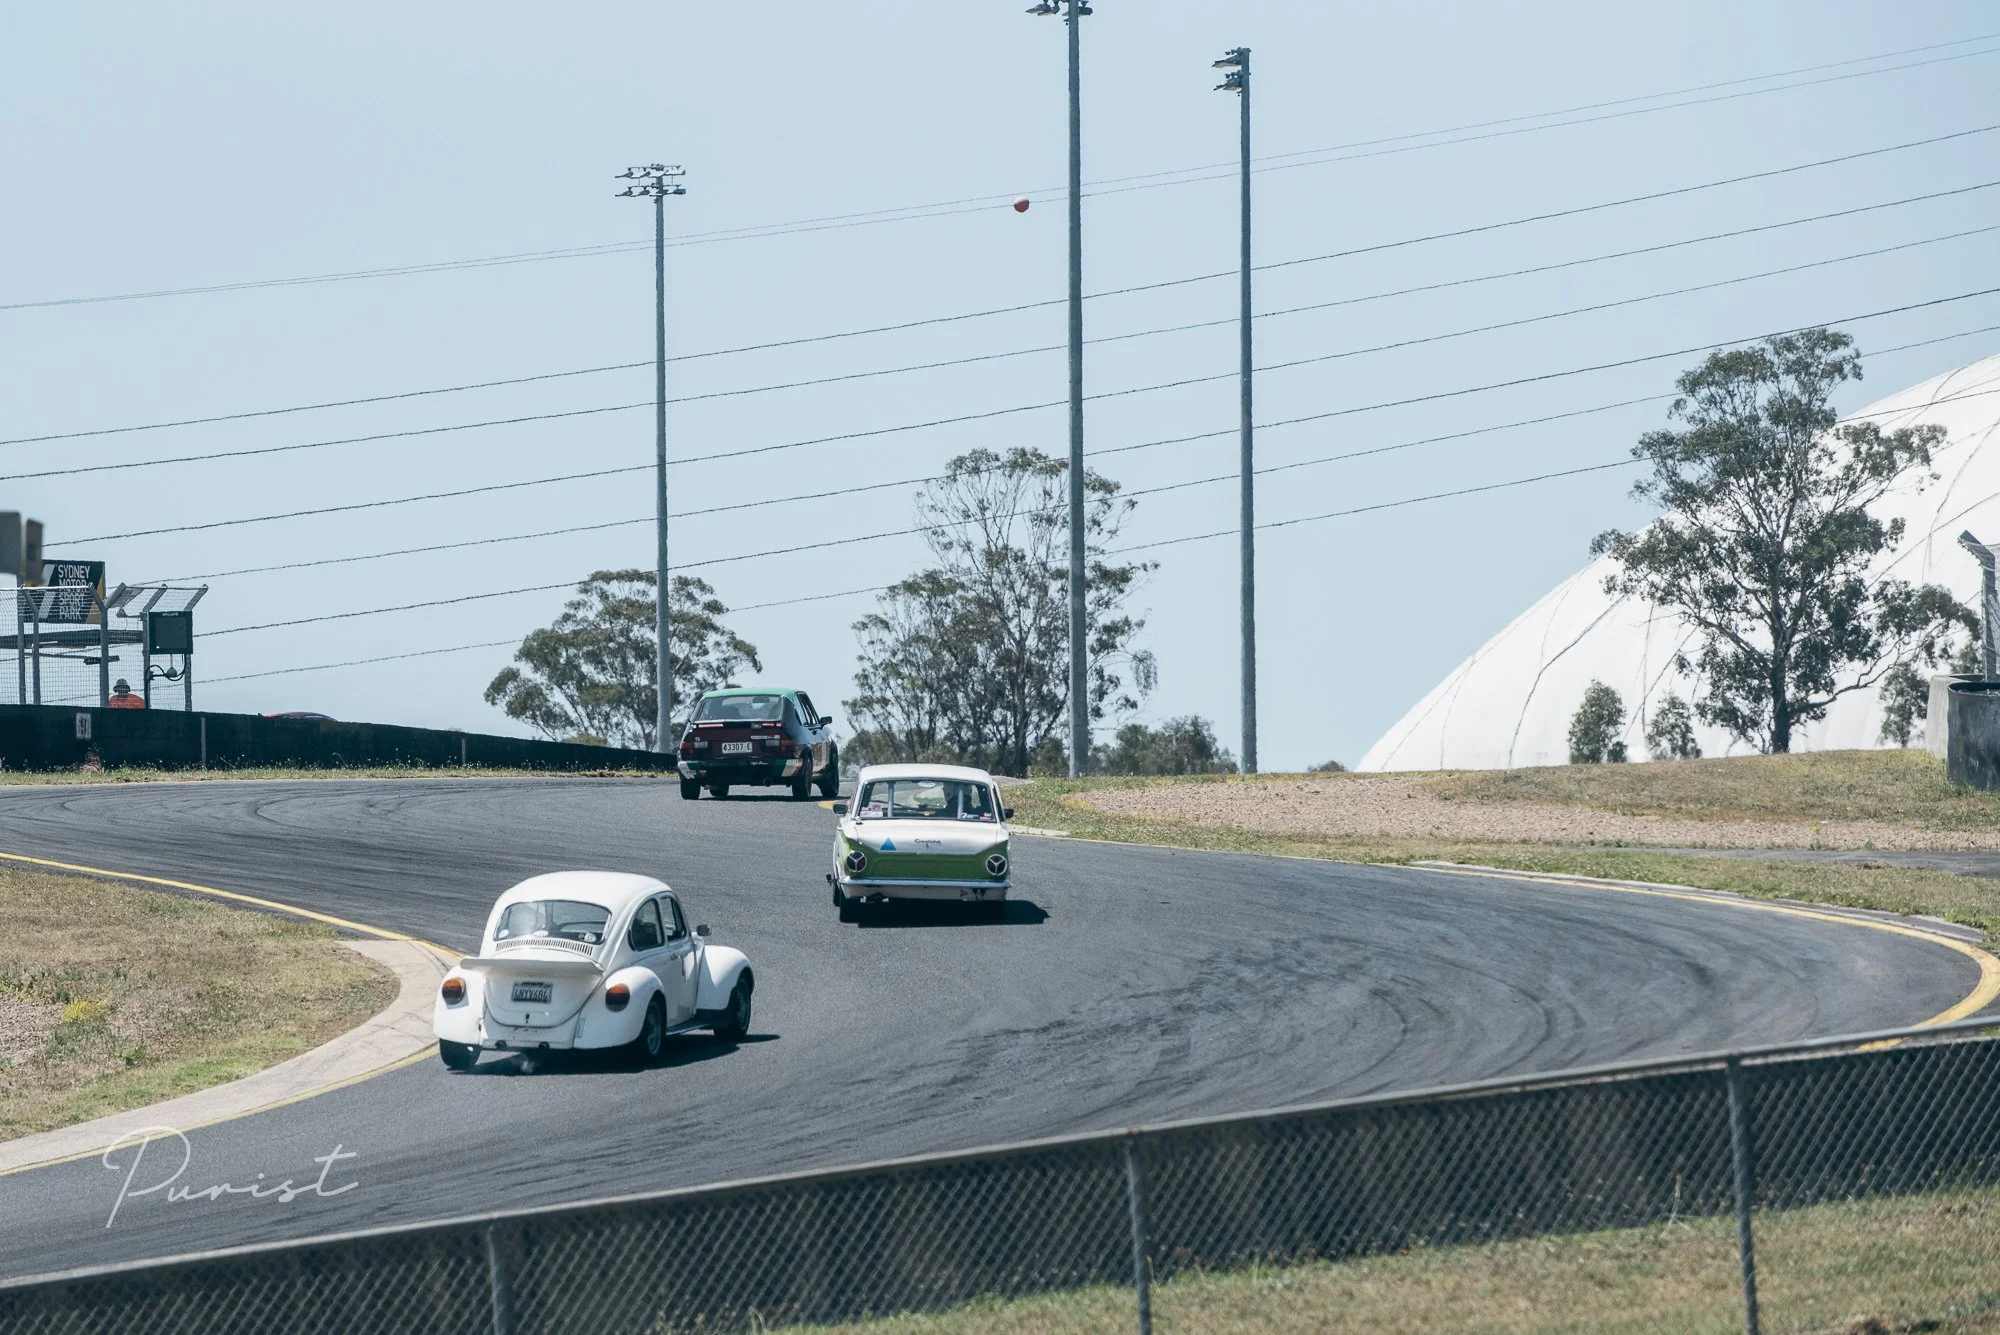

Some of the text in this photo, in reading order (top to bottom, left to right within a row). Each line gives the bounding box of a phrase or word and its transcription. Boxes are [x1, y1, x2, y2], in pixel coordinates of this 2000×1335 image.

[58, 565, 90, 579] SYDNEY
[58, 579, 87, 592] MOTOR
[58, 592, 85, 607] SPORT
[59, 606, 81, 620] PARK
[723, 743, 751, 751] 43307 E
